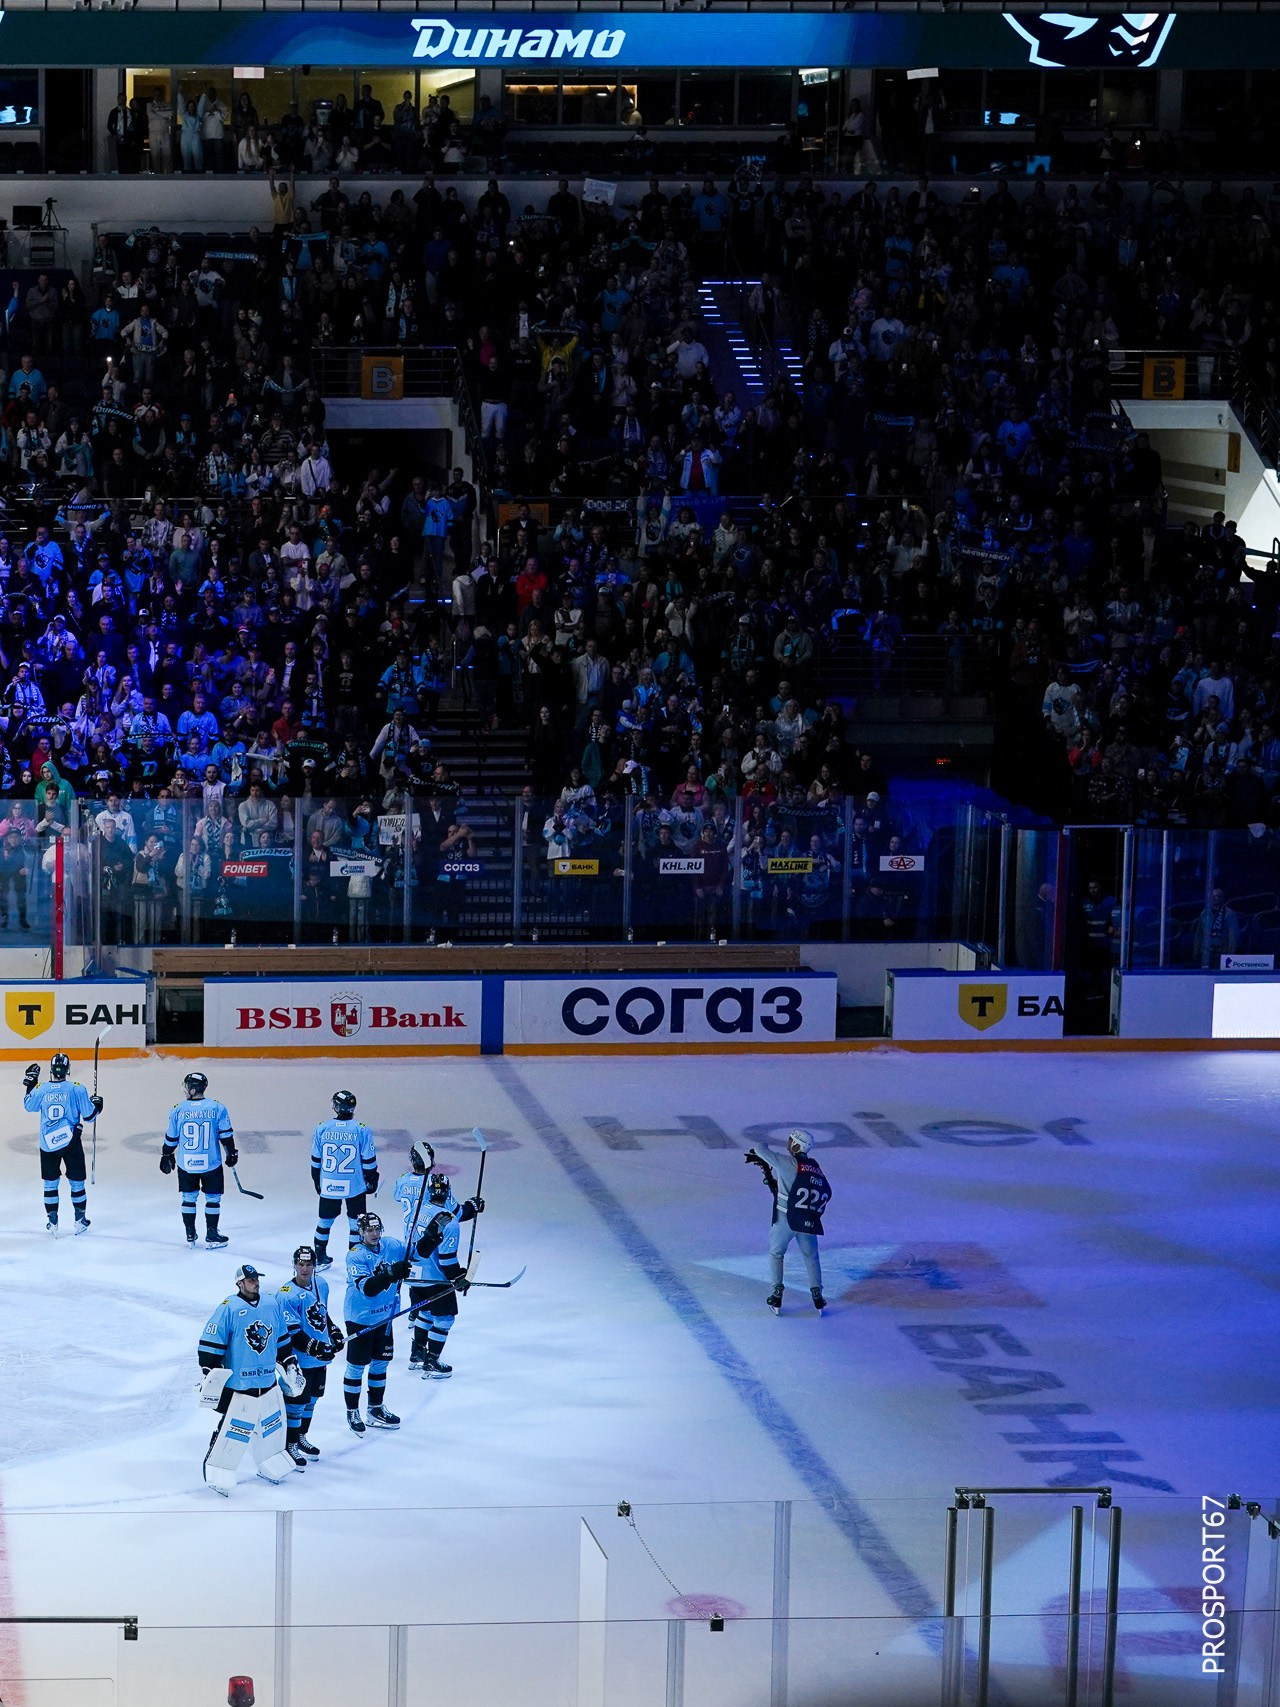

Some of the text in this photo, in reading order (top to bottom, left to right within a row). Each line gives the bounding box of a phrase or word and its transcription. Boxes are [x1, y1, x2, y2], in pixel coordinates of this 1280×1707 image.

[411, 18, 627, 58] Динамо
[223, 864, 266, 874] FONBET
[444, 863, 480, 872] согаз
[662, 861, 702, 870] KHL.RU
[1232, 960, 1271, 968] Ростелеком
[235, 1005, 467, 1029] BSB Bank
[561, 985, 804, 1036] согаз
[44, 1093, 69, 1103] LIPSKY
[182, 1121, 211, 1151] 91
[586, 1112, 1092, 1150] Haier
[320, 1142, 357, 1175] 62
[403, 1185, 423, 1197] SMITH
[205, 1323, 218, 1336] 60
[899, 1322, 1176, 1494] БАНК
[230, 1427, 251, 1436] TRUE
